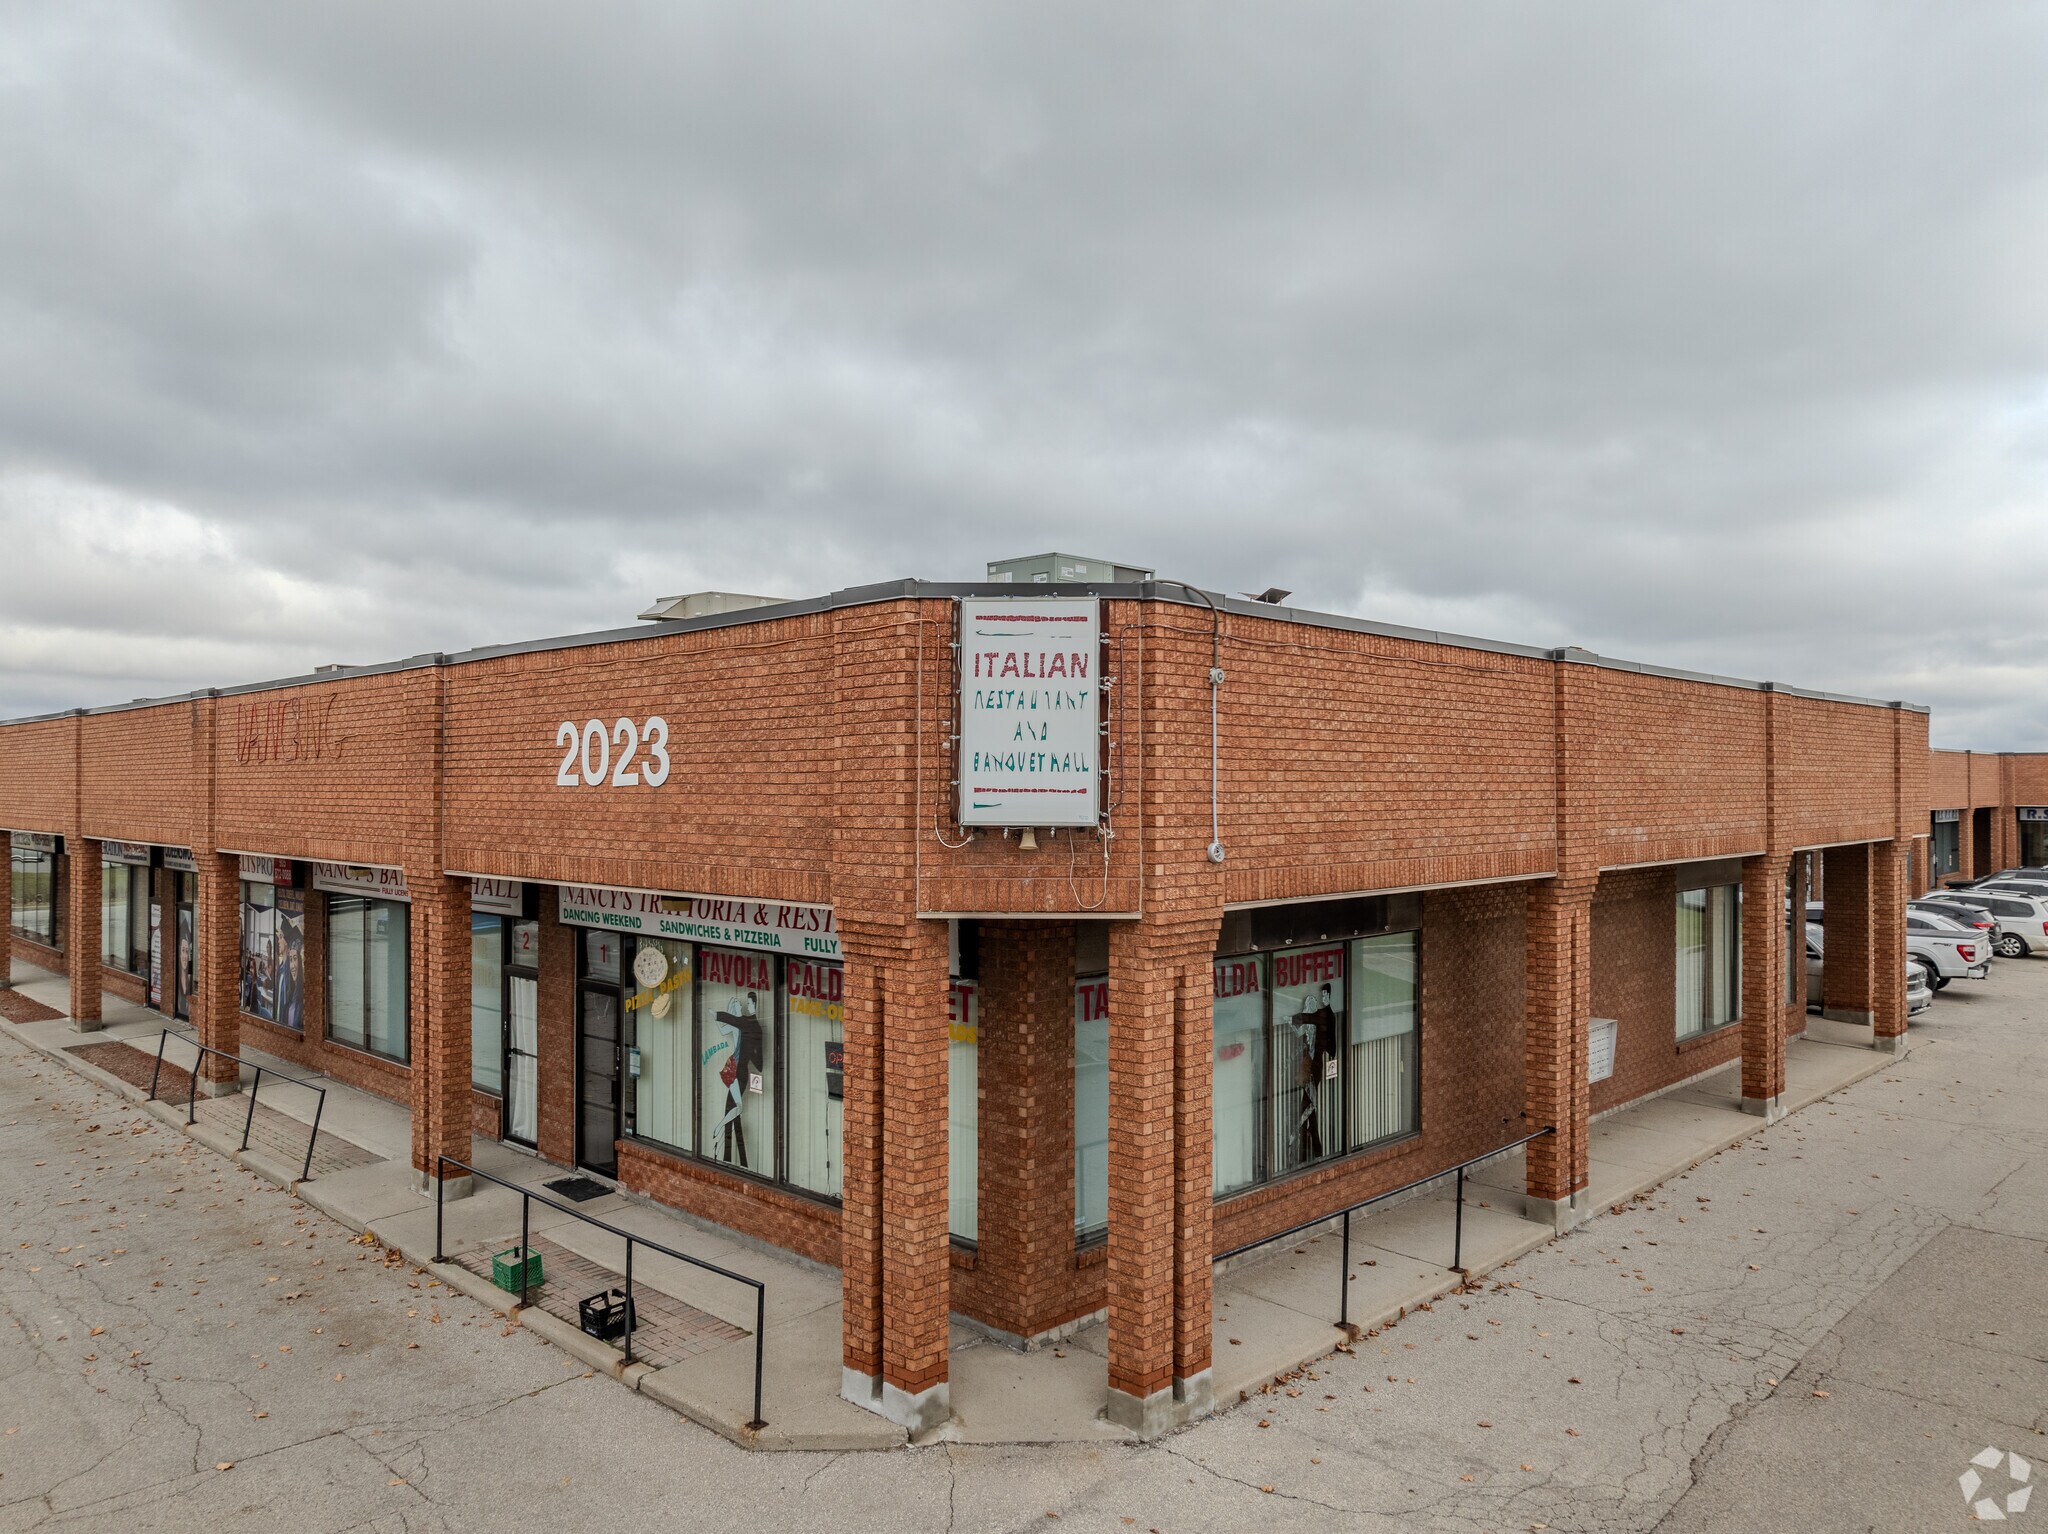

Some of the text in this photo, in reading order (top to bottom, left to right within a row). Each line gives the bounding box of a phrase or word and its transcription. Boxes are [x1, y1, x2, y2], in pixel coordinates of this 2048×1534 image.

[974, 653, 1088, 678] ITALIAN
[557, 716, 670, 788] 2023
[973, 751, 1089, 772] BANQUET HALL
[240, 855, 273, 876] LTSPRO
[314, 862, 374, 883] NANCS
[639, 893, 746, 923] TRTORIA
[753, 903, 769, 926] &
[776, 905, 838, 934] REST
[523, 931, 530, 950] 2
[563, 908, 838, 954] DANCING WEEKEND SANDWICHES & PIZZERIA FULLY
[600, 944, 606, 963] 1
[660, 967, 692, 994] PASTA
[700, 950, 770, 991] TAVOLA
[1276, 948, 1345, 988] BUFFET
[625, 991, 654, 1013] PIZZA
[702, 1041, 729, 1066] LAMBADA
